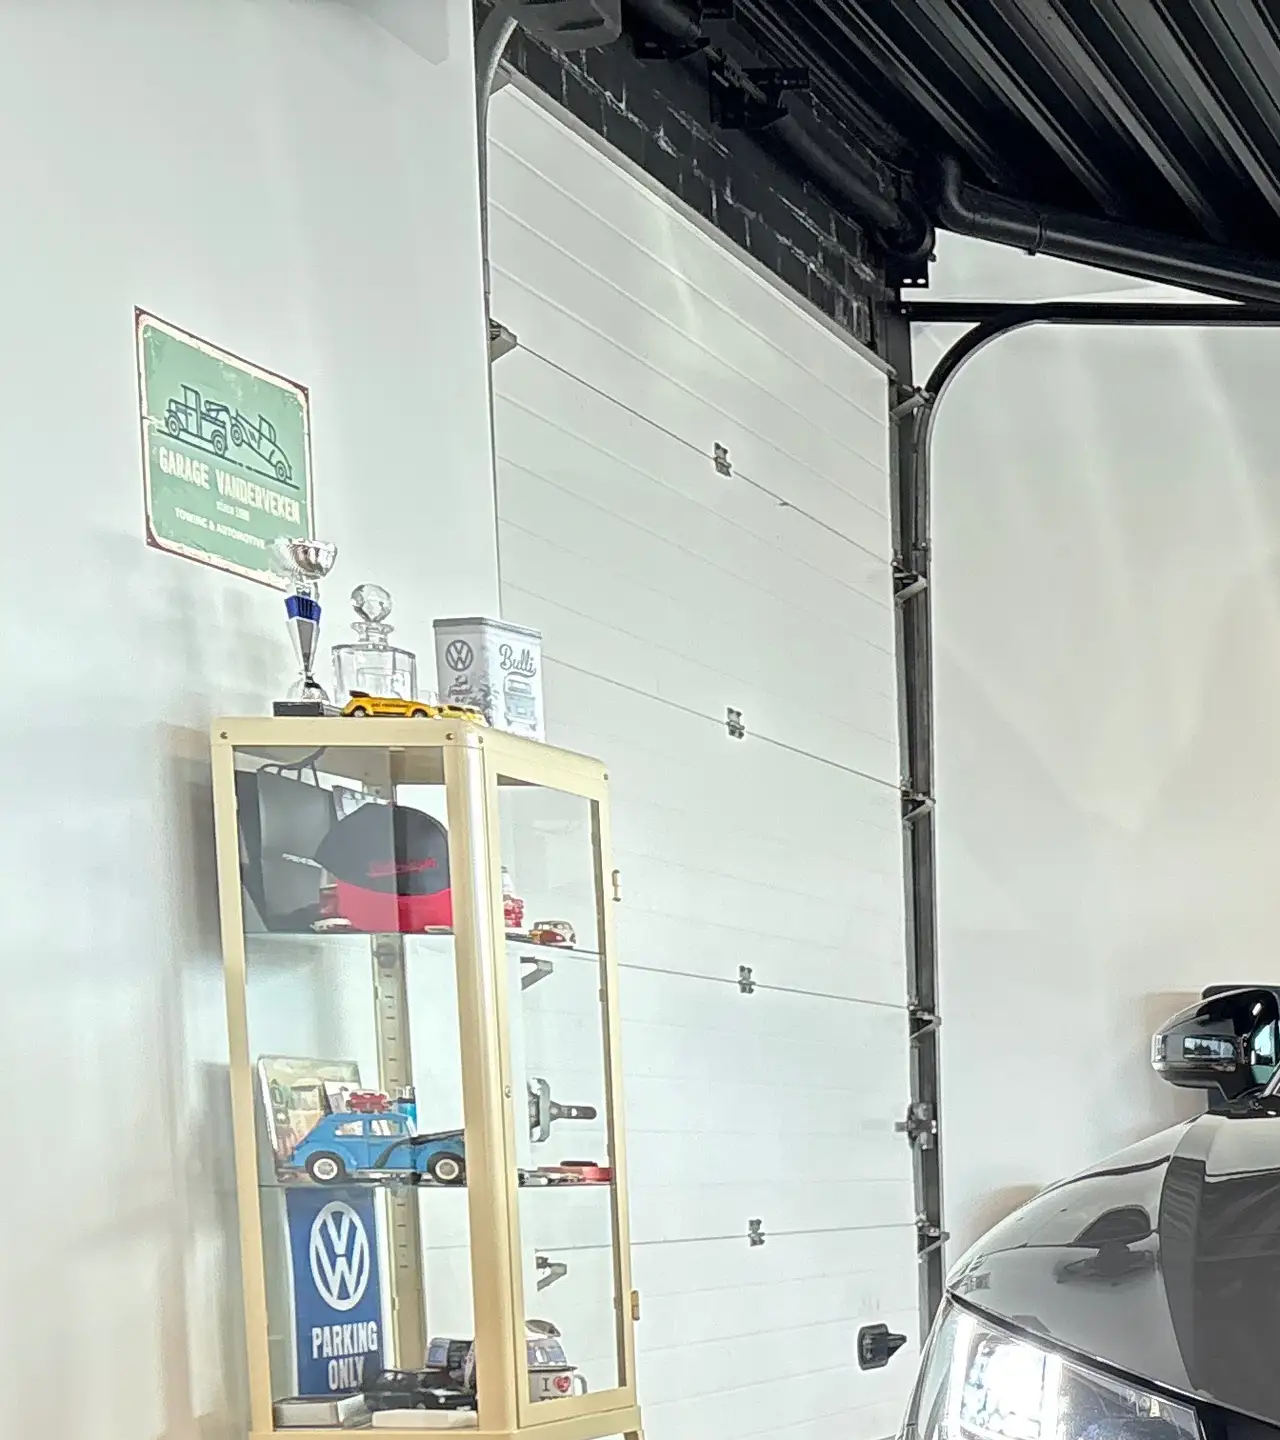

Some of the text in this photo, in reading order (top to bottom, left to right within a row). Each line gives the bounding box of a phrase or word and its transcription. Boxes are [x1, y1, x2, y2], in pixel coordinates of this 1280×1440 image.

[159, 446, 210, 490] GARAGE
[215, 468, 300, 525] VANDERVEKEN
[499, 643, 536, 678] Bulli
[311, 1320, 379, 1360] PARKING
[328, 1357, 365, 1390] ONLY
[542, 1377, 550, 1392] I
